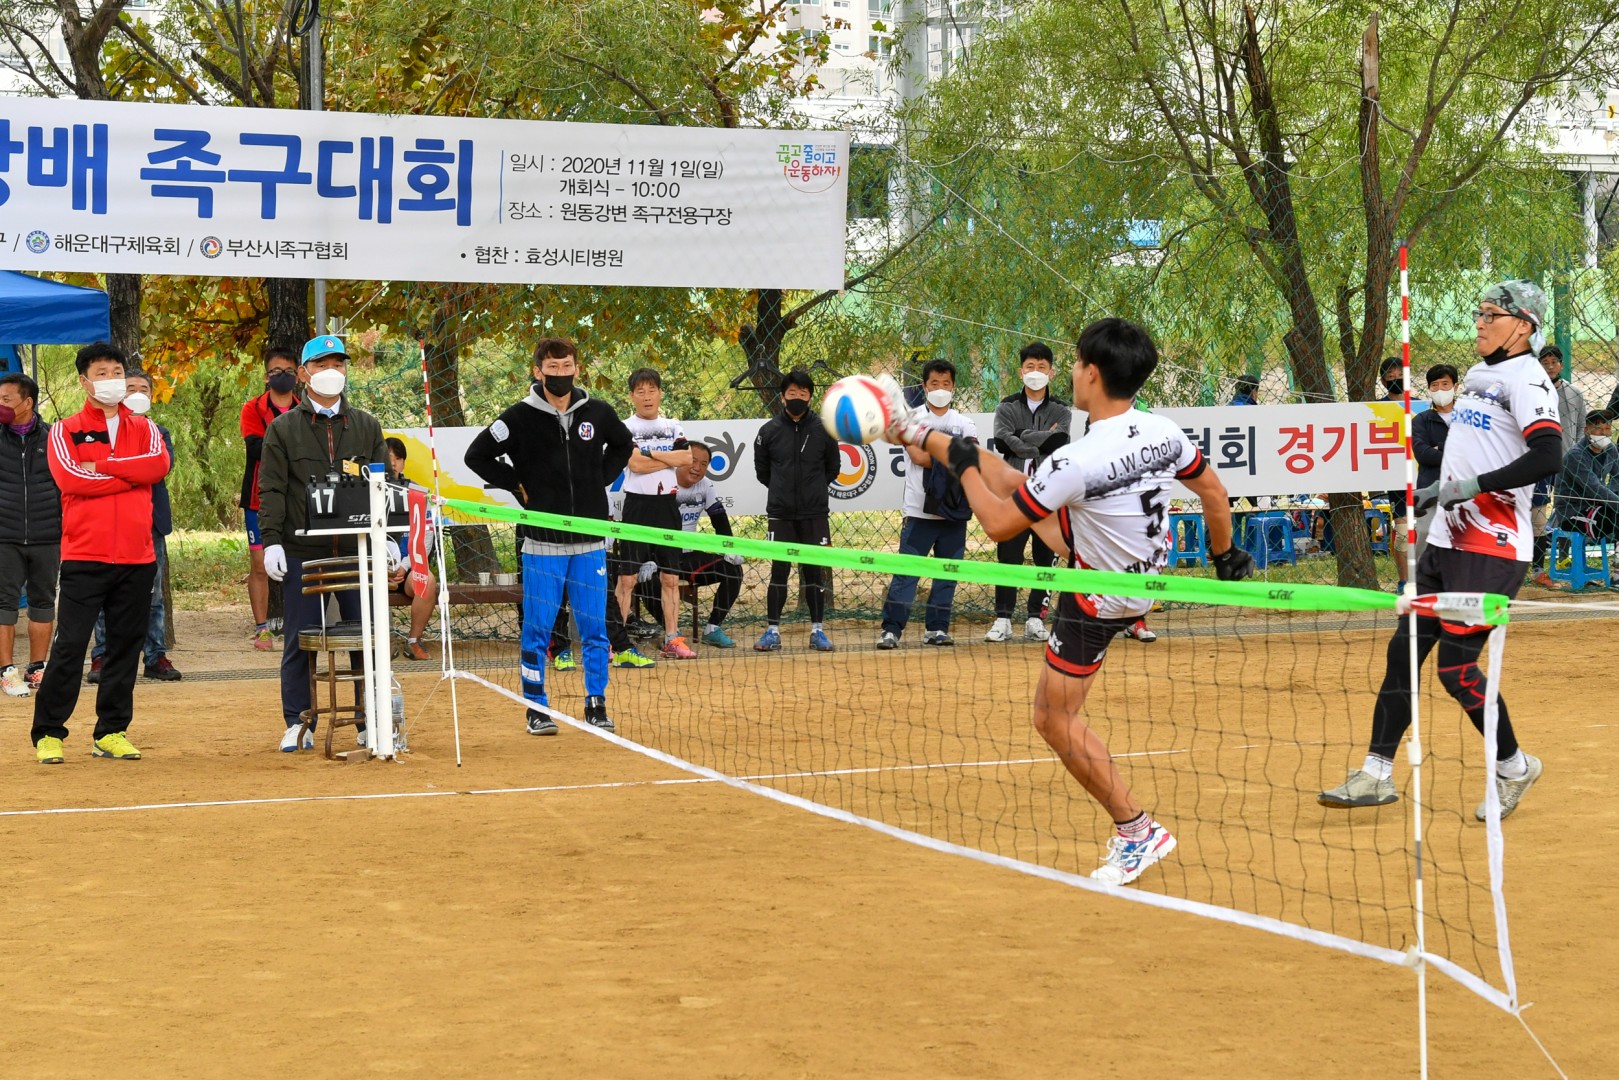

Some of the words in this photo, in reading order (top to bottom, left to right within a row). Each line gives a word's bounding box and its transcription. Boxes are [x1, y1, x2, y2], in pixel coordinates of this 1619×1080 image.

[140, 128, 473, 226] 족구대회
[510, 154, 544, 173] 일시
[561, 156, 621, 176] 2020년
[628, 159, 664, 177] 11월
[670, 160, 724, 180] 1일(일)
[559, 178, 610, 197] 개회식
[631, 181, 680, 198] 10:00
[508, 202, 543, 220] 장소
[560, 203, 628, 222] 원동강변
[632, 205, 733, 226] 족구전용구장
[54, 233, 180, 256] 해운대구체육회
[226, 239, 348, 260] 부산시족구협회
[474, 246, 509, 265] 협찬
[525, 248, 624, 267] 효성시티병원
[1107, 437, 1172, 481] J.W.Choi
[1277, 421, 1406, 474] 경기부
[311, 488, 335, 513] 17
[1140, 486, 1165, 538] 5
[347, 513, 371, 522] sta
[412, 503, 424, 565] 2
